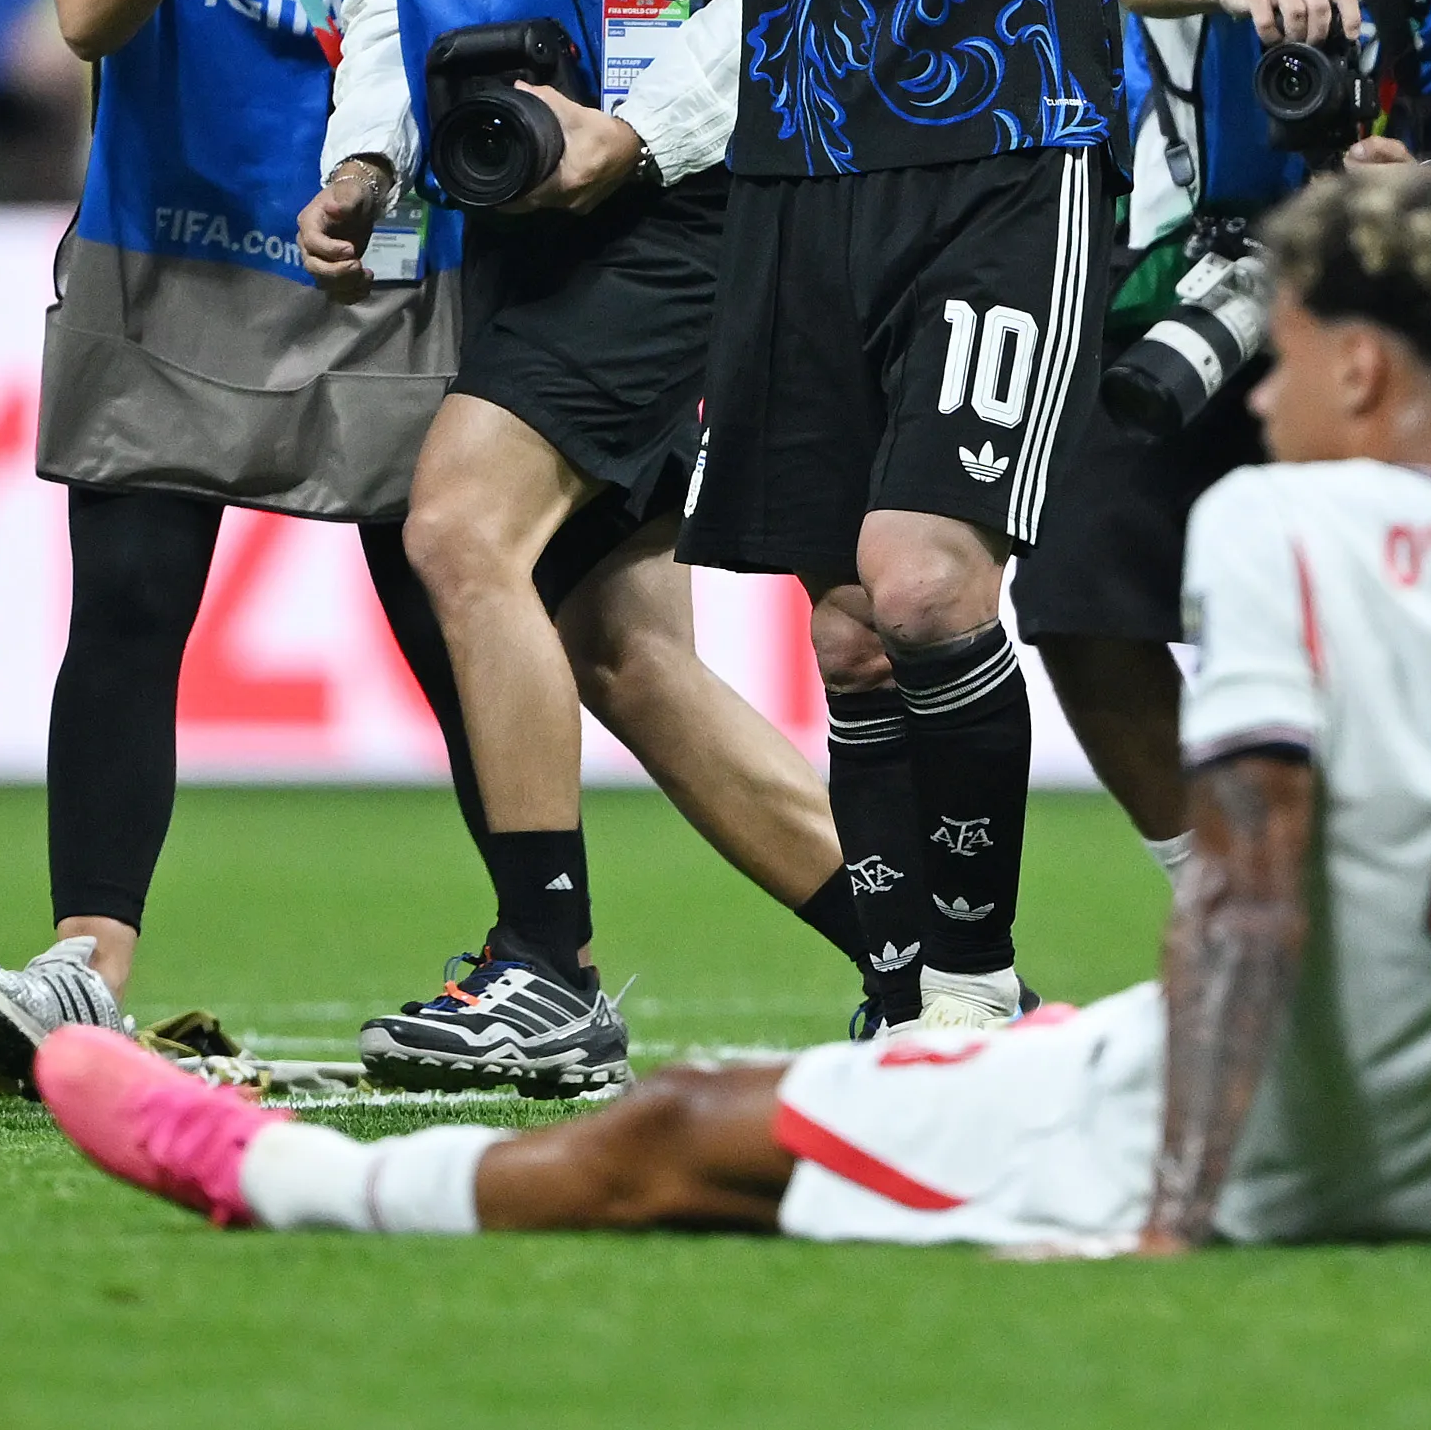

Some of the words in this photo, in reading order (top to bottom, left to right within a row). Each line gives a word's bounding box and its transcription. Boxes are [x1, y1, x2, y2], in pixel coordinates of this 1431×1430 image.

[608, 7, 622, 15] FIFA
[622, 7, 645, 15] WORLD
[645, 7, 659, 15] CUP
[937, 299, 1039, 430] 10
[929, 815, 994, 857] AFA
[845, 854, 905, 896] AFA
